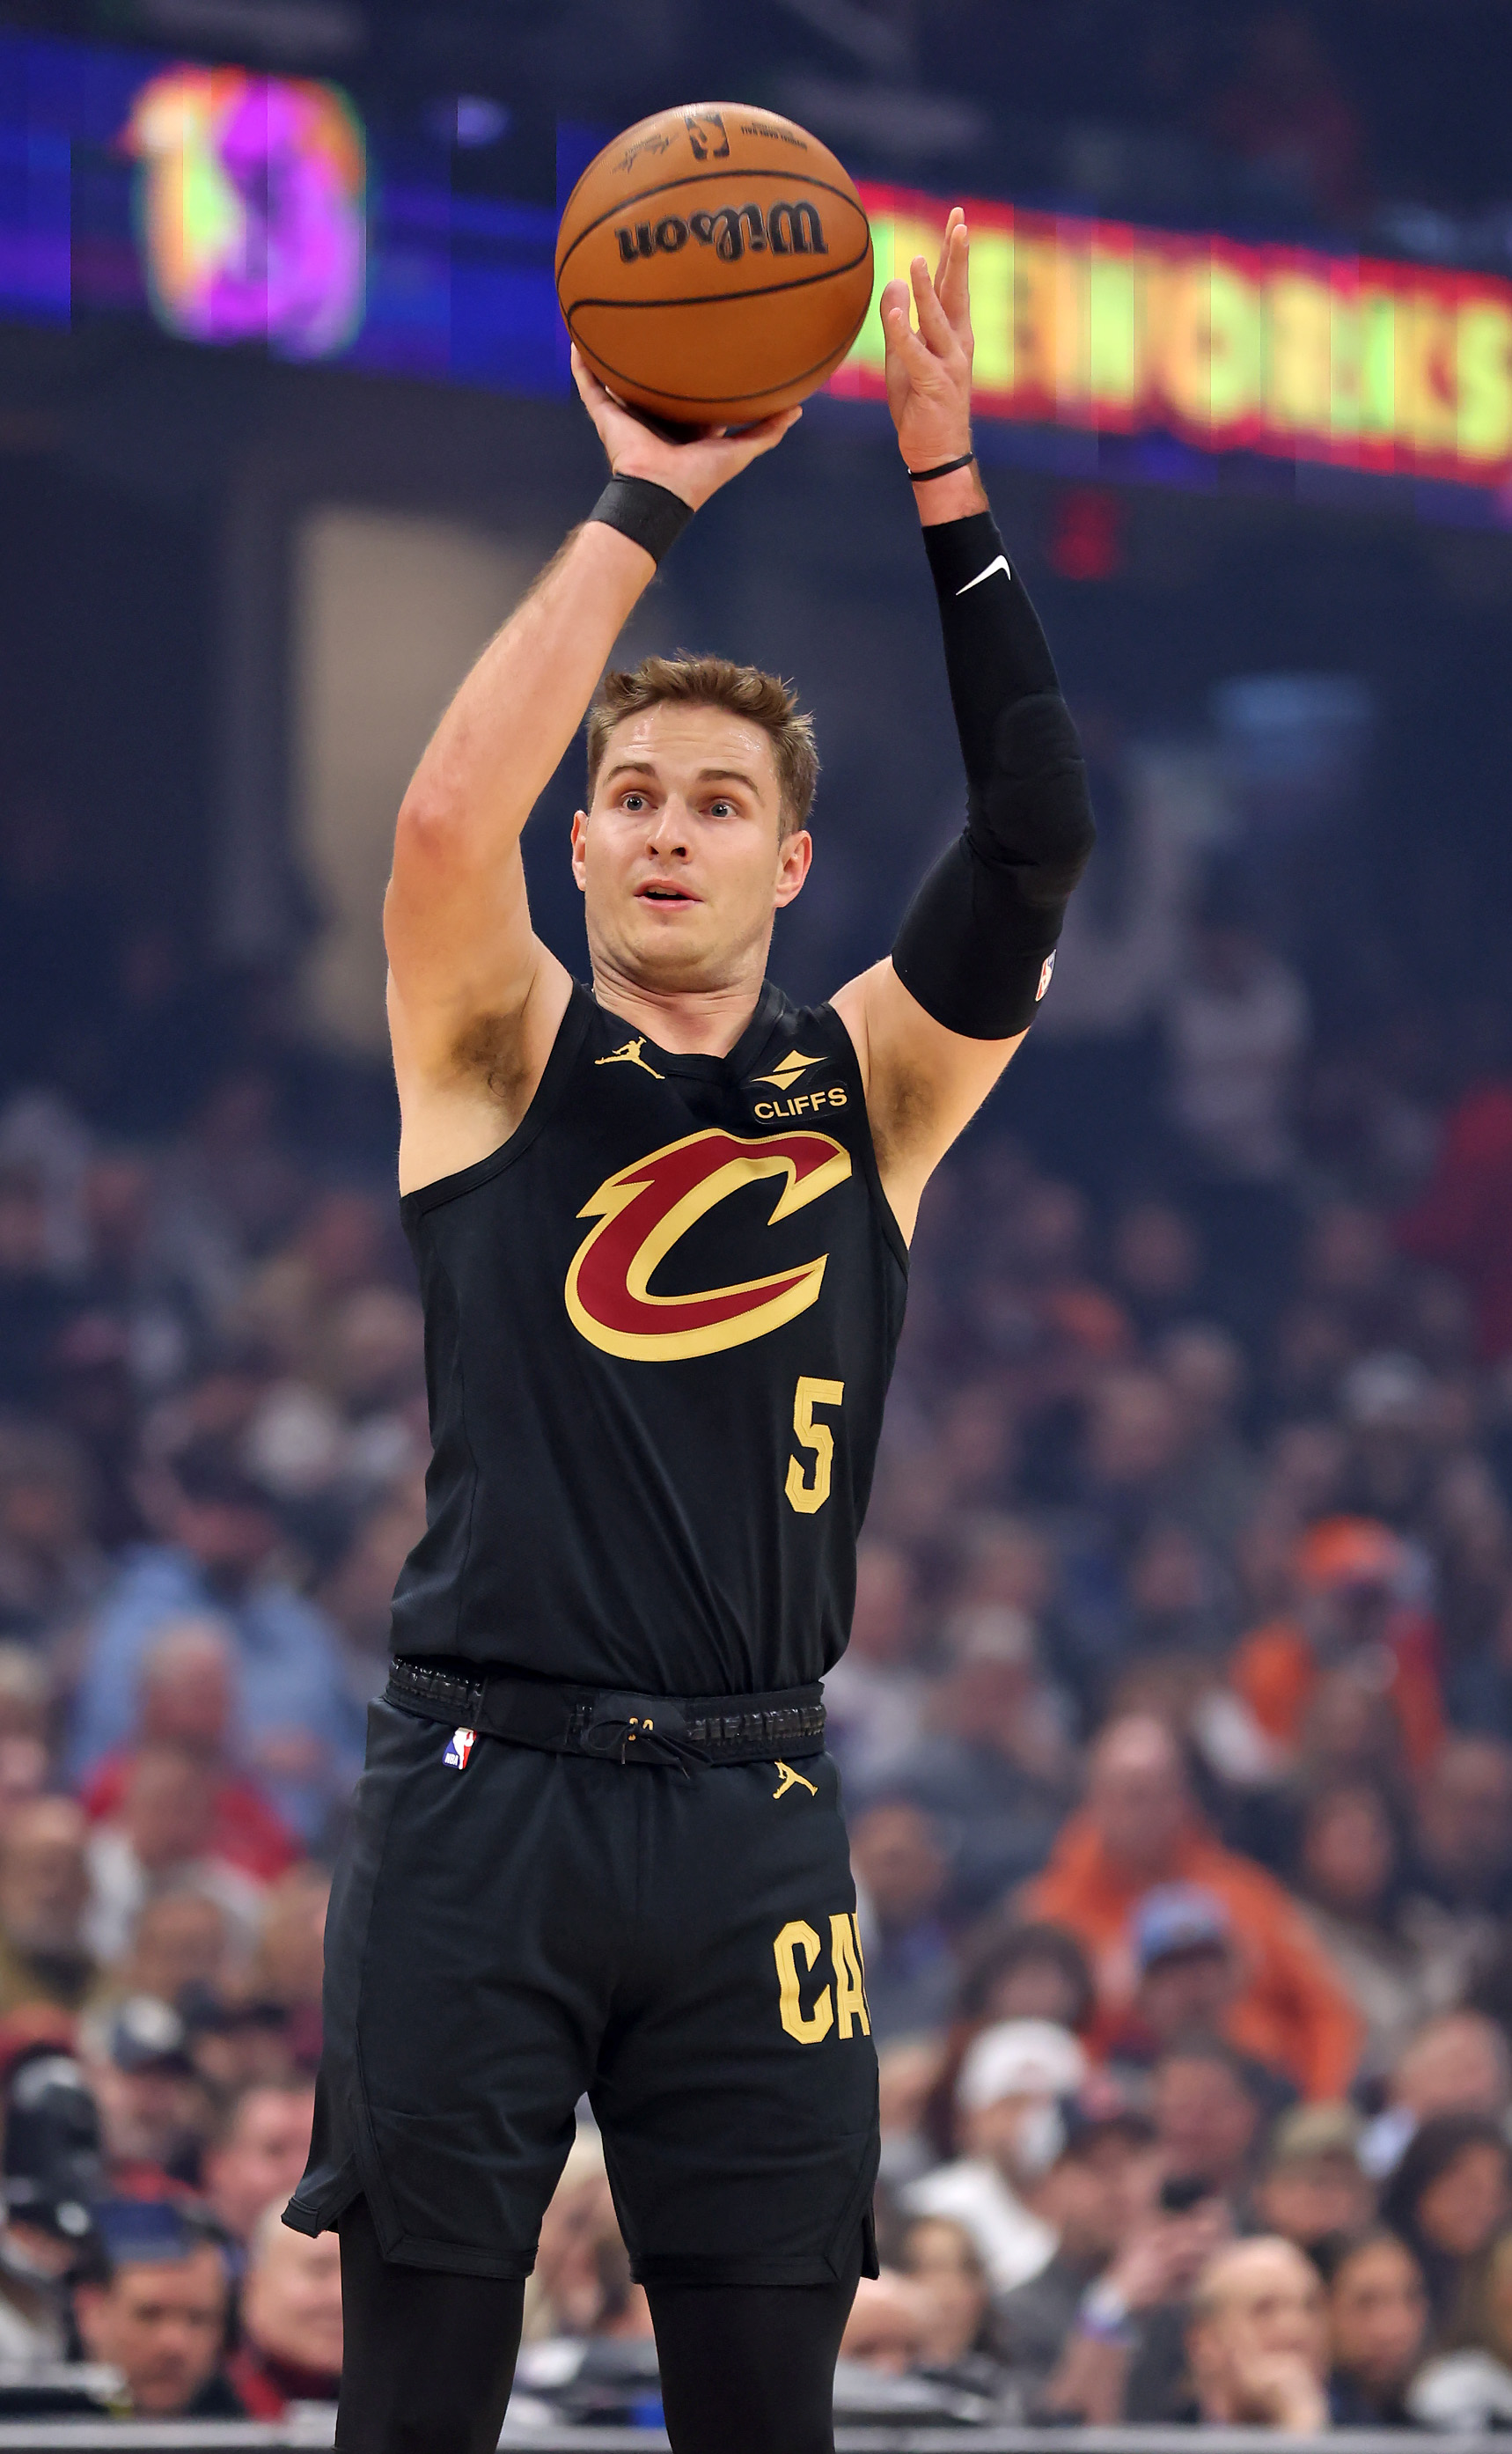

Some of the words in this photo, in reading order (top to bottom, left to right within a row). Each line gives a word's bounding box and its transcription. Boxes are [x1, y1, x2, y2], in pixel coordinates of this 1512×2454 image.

[614, 200, 829, 263] Wilson
[754, 1087, 848, 1120] CLIFFS
[564, 1128, 852, 1362] C
[784, 1376, 845, 1514] 5
[444, 1752, 459, 1767] NBA
[773, 1913, 872, 2045] CA
